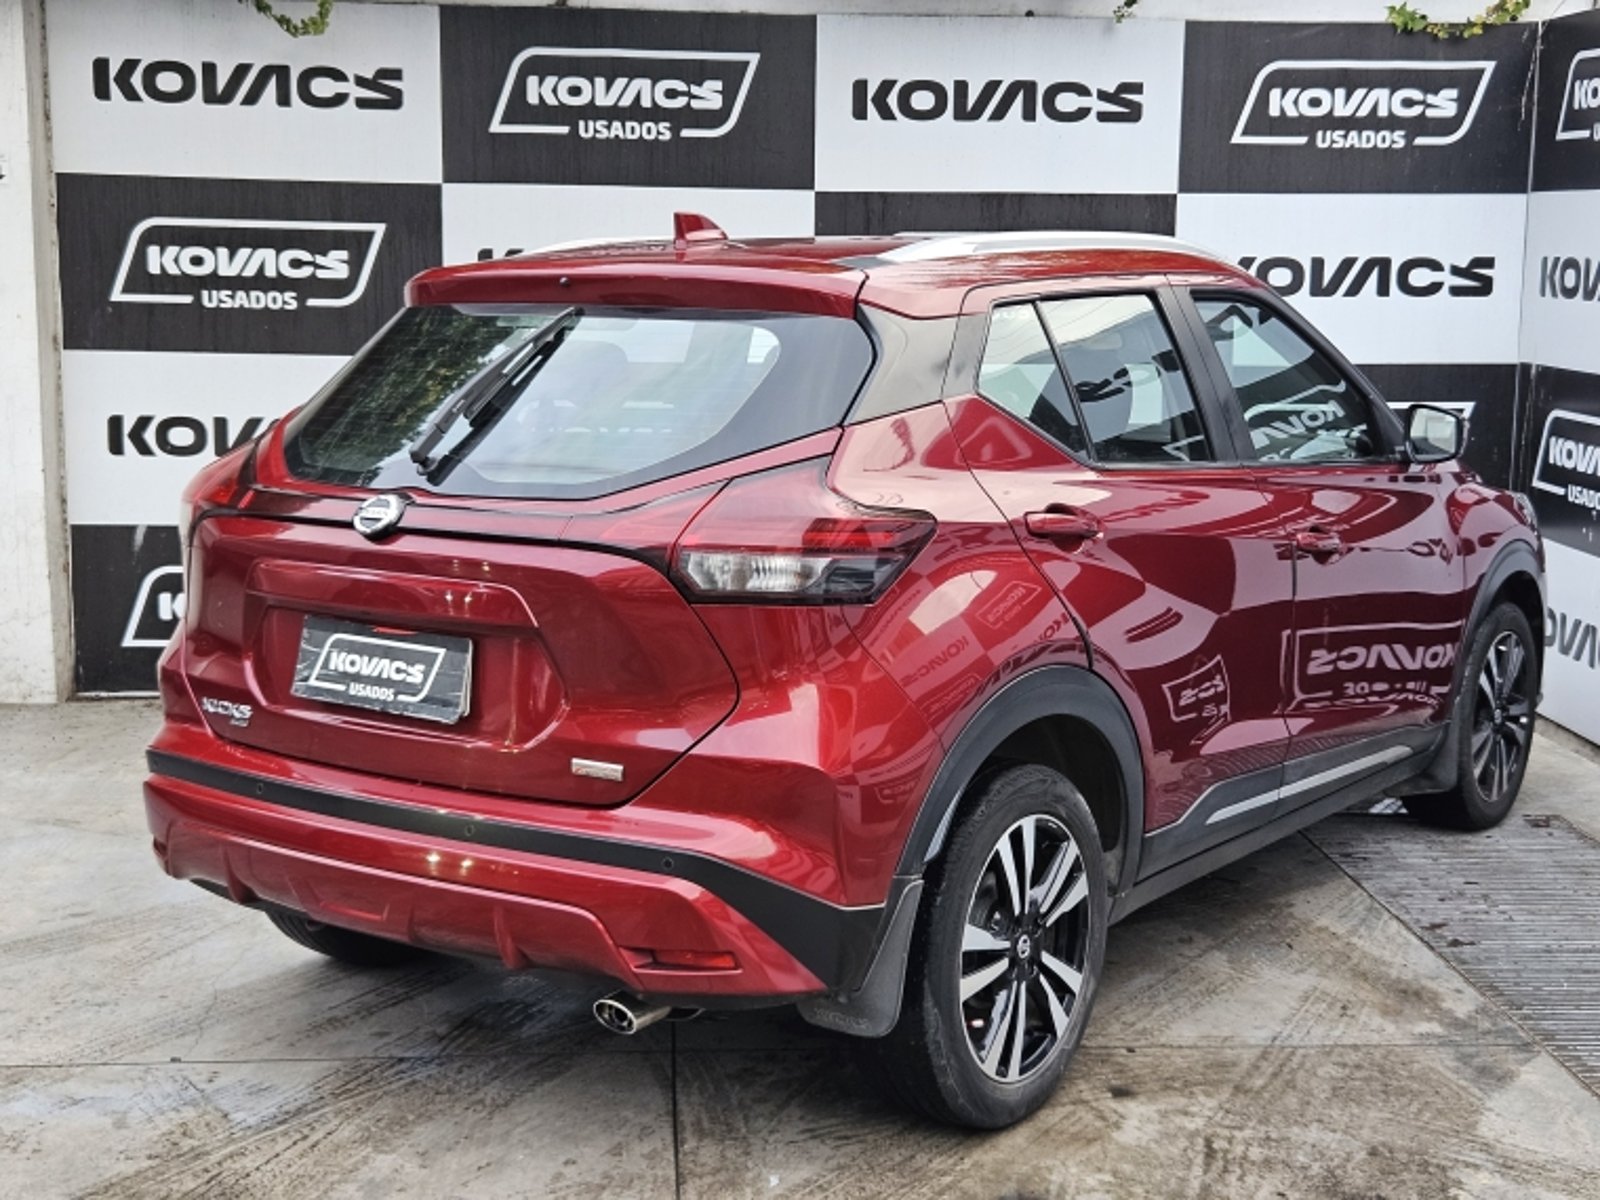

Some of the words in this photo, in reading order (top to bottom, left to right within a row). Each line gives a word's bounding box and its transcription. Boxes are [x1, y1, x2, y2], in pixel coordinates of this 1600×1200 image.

[92, 57, 404, 111] KOVACS
[526, 75, 723, 110] KOVACS
[851, 78, 1144, 124] KOVACS
[1268, 86, 1458, 119] KOVACS
[578, 119, 672, 141] USADOS
[1315, 129, 1406, 149] USADOS
[146, 244, 350, 280] KOVACS
[1238, 256, 1495, 297] OVACS
[1540, 256, 1600, 302] KOV
[201, 289, 298, 311] USADOS
[107, 415, 280, 457] KOV
[328, 651, 426, 684] KOVACS
[349, 681, 395, 702] USADOS
